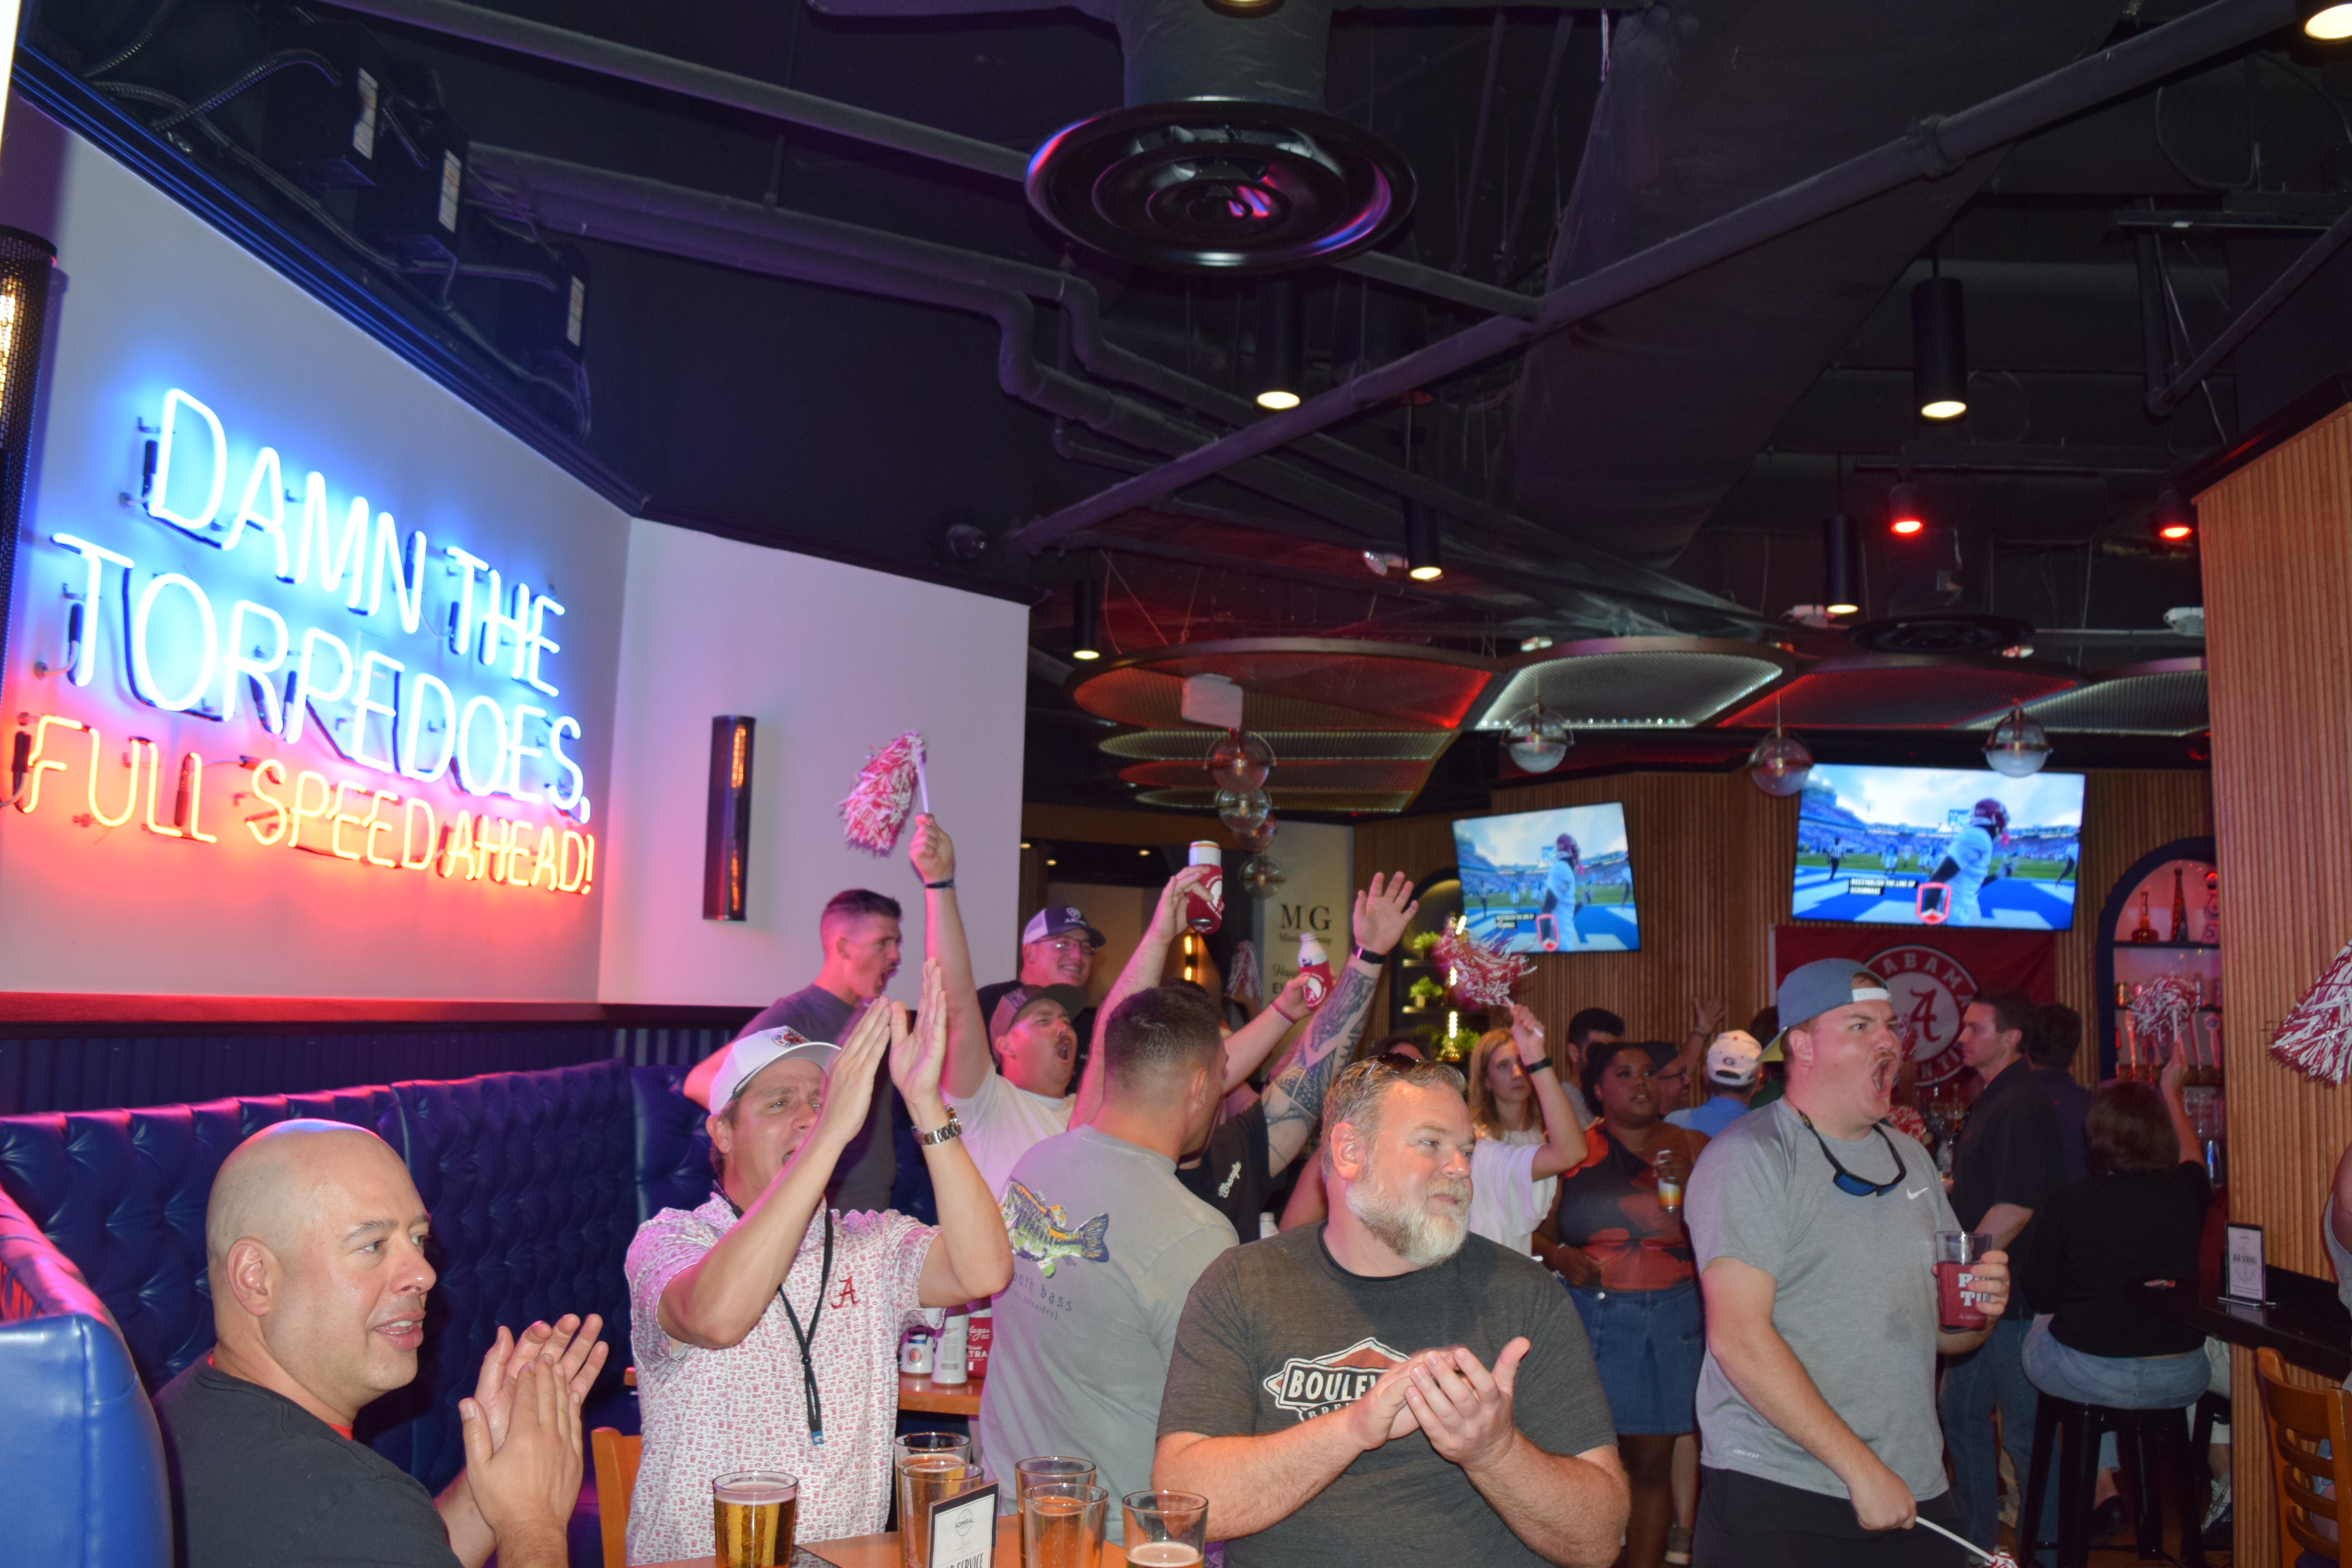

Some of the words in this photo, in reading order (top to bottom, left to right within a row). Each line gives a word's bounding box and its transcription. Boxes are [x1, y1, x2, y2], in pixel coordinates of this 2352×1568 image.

[148, 388, 427, 634] DAMN
[446, 546, 565, 697] THE
[52, 533, 591, 824] TORPEDOES,
[23, 715, 217, 843] FULL
[246, 759, 435, 870] SPEED
[443, 809, 594, 895] AHEAD!
[1205, 875, 1219, 888] NATIONAL
[831, 1275, 860, 1310] A
[1041, 1284, 1072, 1311] bass
[955, 1517, 974, 1529] ADMIRAL
